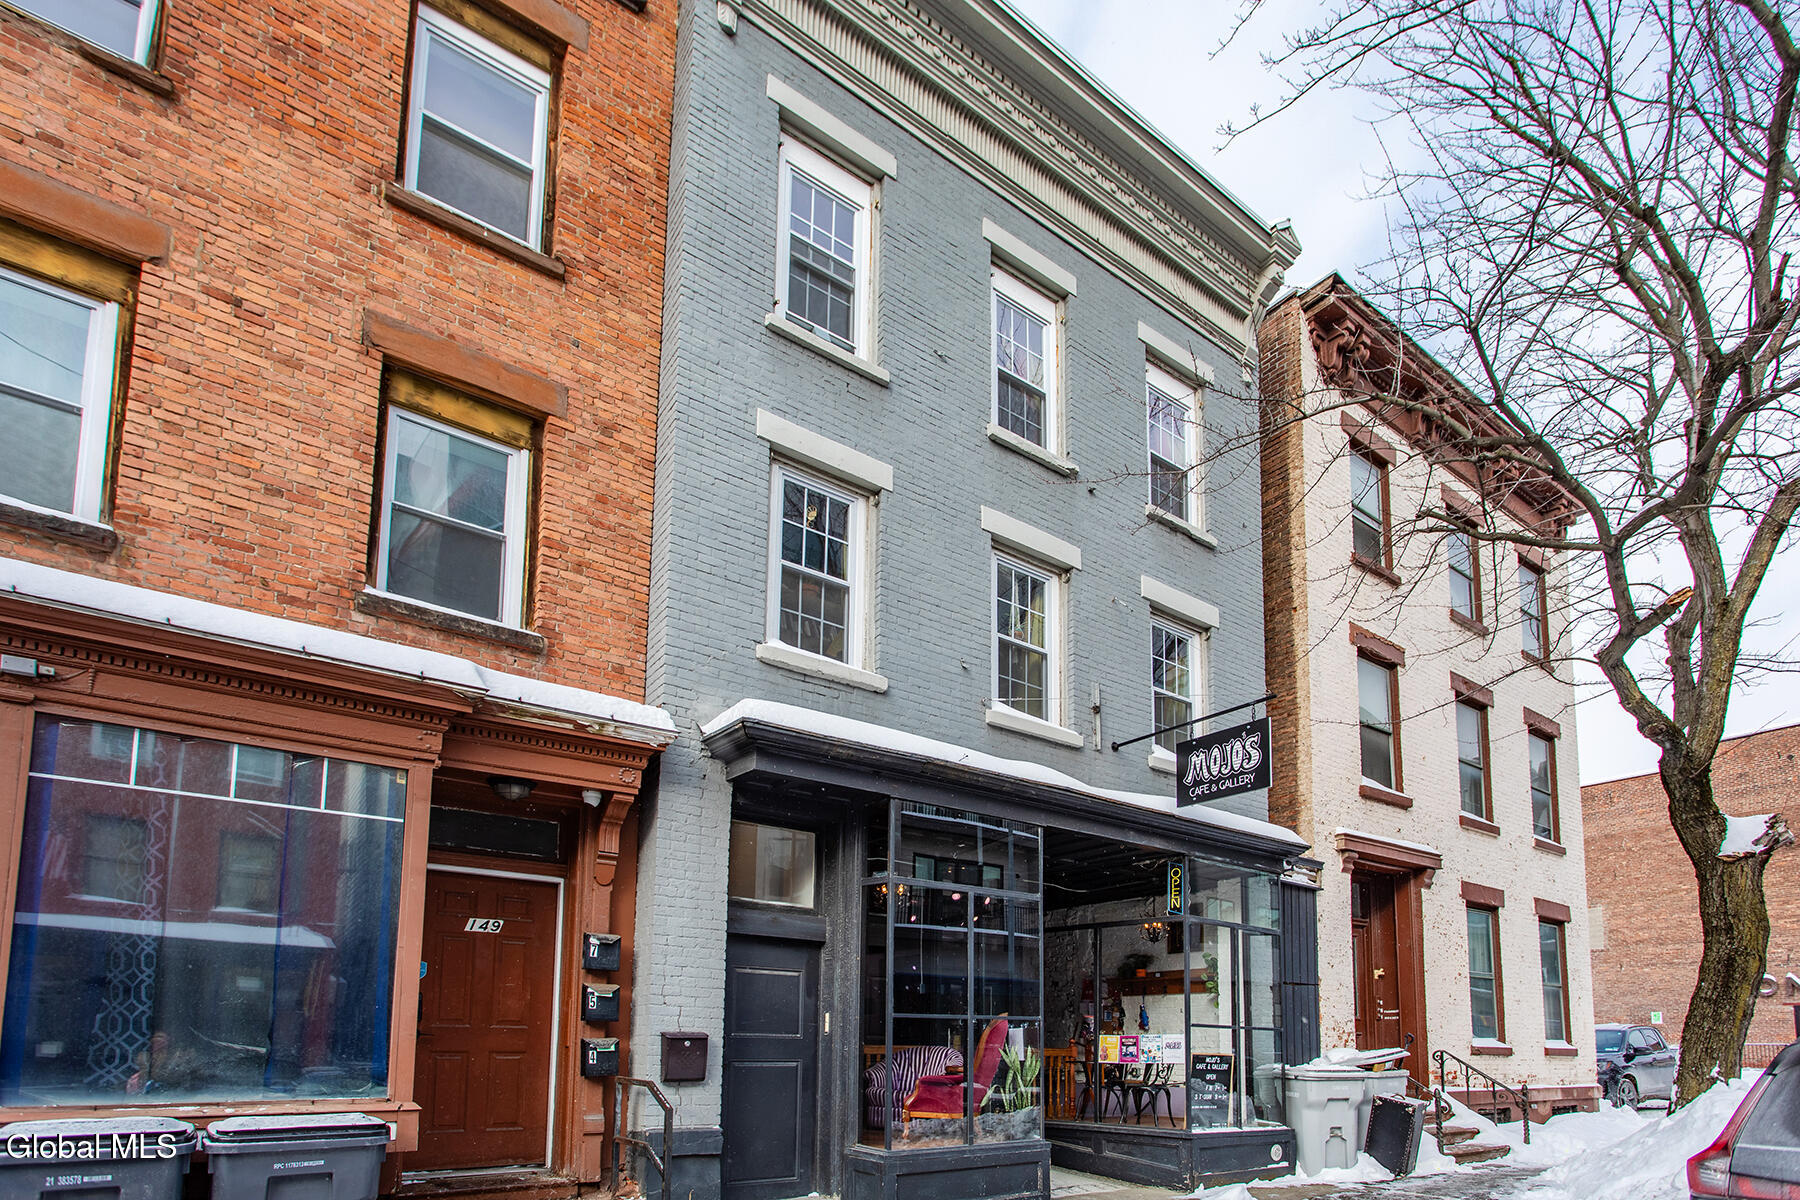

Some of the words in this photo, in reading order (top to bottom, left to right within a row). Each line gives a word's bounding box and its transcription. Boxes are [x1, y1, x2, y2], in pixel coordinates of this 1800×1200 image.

[1183, 731, 1263, 786] MOJO'S
[1189, 783, 1210, 797] CAFE
[1210, 783, 1218, 792] &
[1218, 773, 1256, 790] GALLERY
[1170, 867, 1182, 909] OPEN
[469, 919, 502, 932] 149
[591, 943, 599, 957] 7
[589, 996, 597, 1008] 5
[589, 1051, 597, 1063] 4
